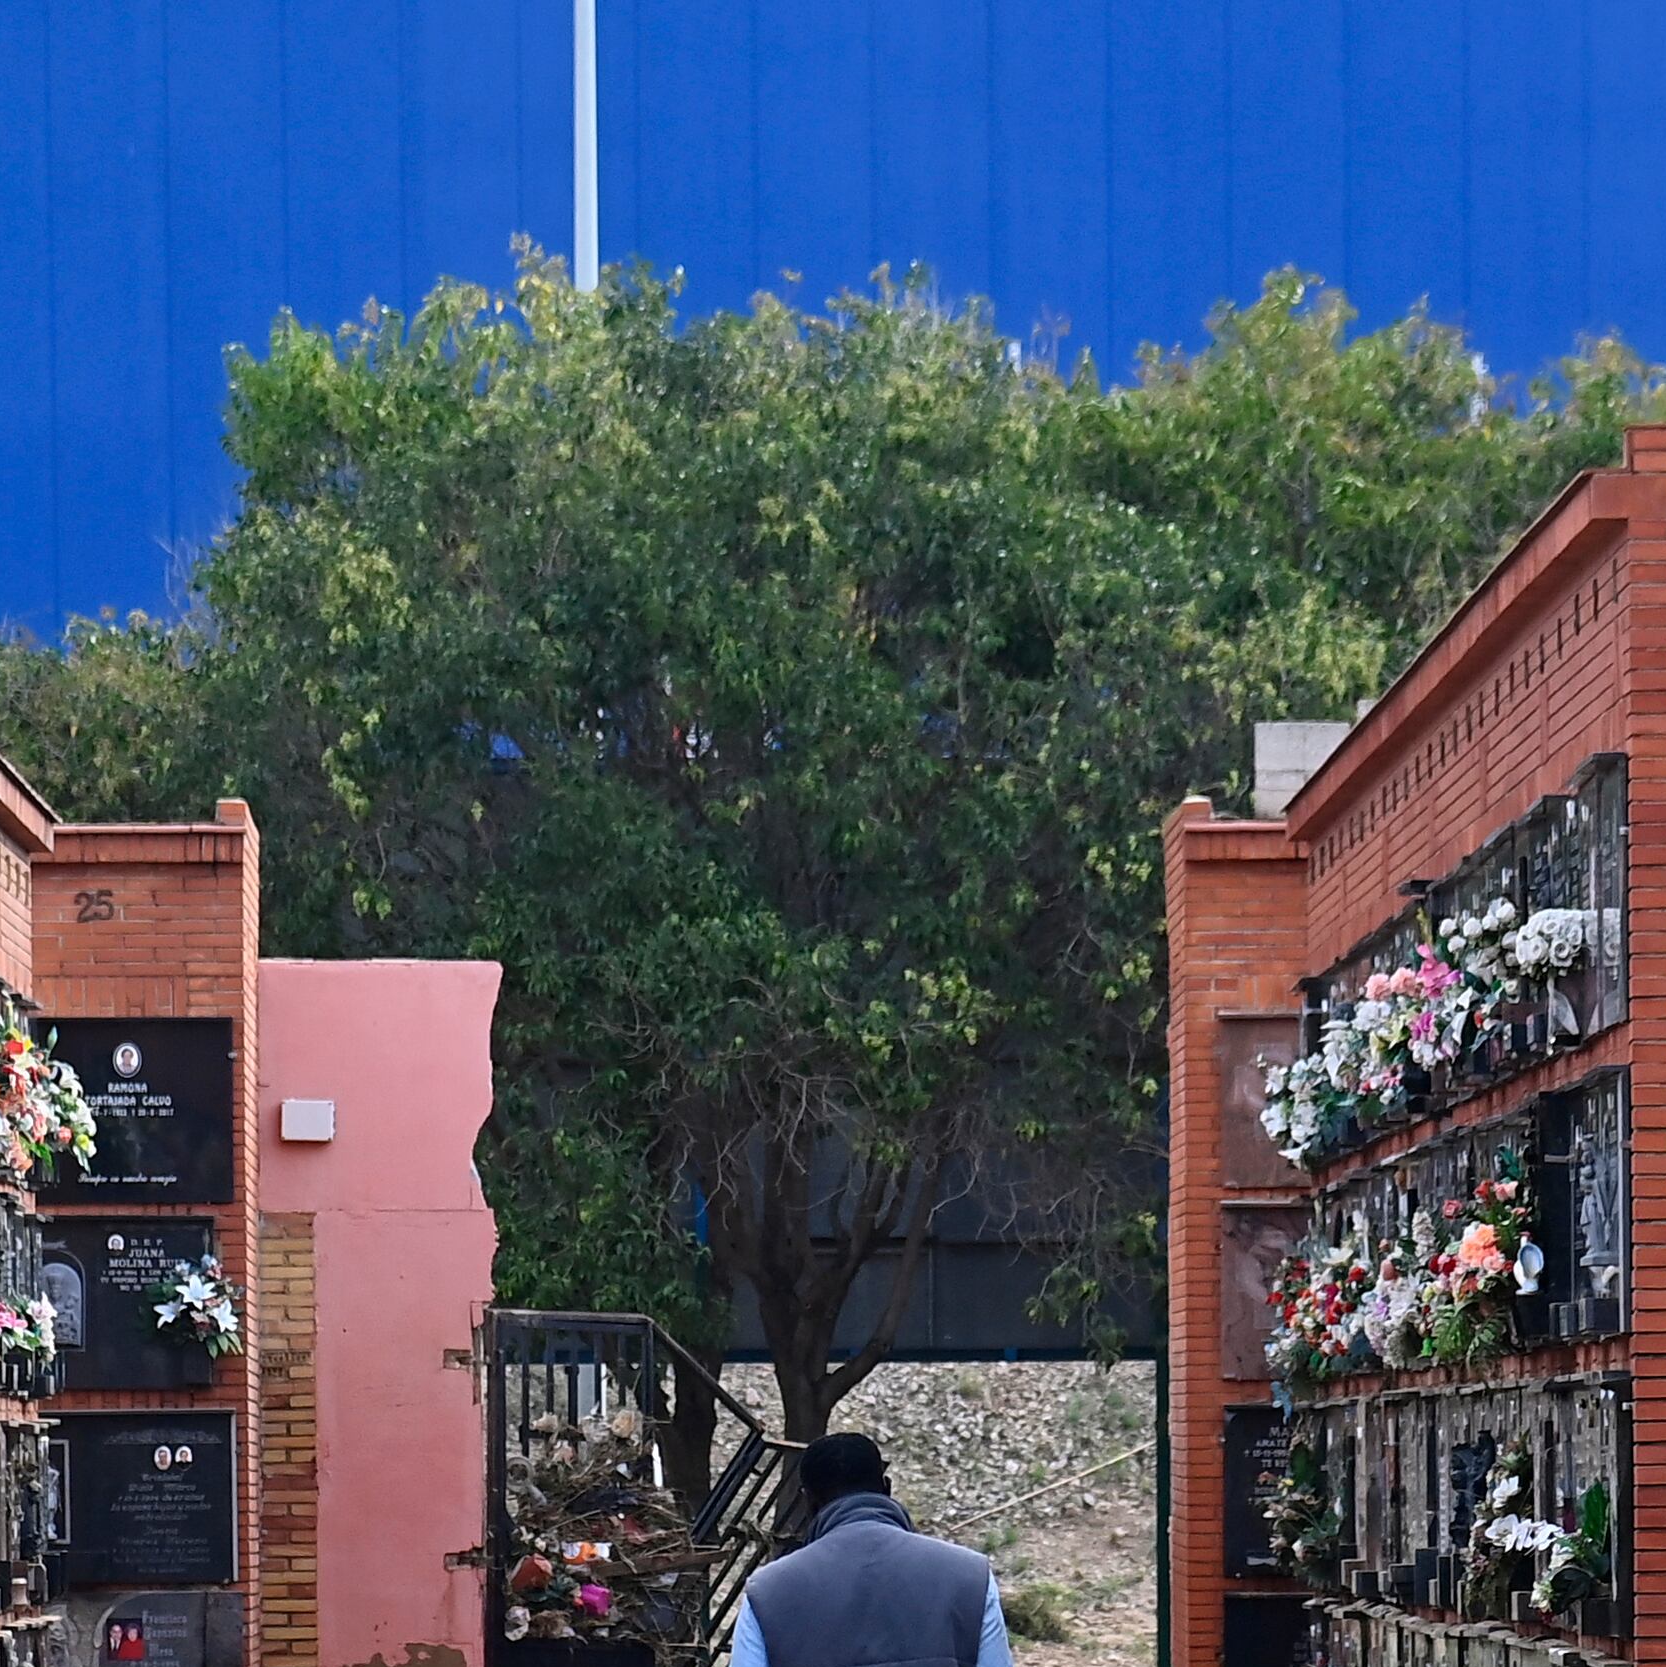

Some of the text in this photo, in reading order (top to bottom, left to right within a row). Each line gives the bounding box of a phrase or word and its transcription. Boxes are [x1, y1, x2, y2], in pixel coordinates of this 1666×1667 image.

[74, 889, 114, 923] 25
[107, 1082, 148, 1094] RAMONA
[128, 1248, 165, 1258] JUANA
[108, 1258, 153, 1268] MOLINA
